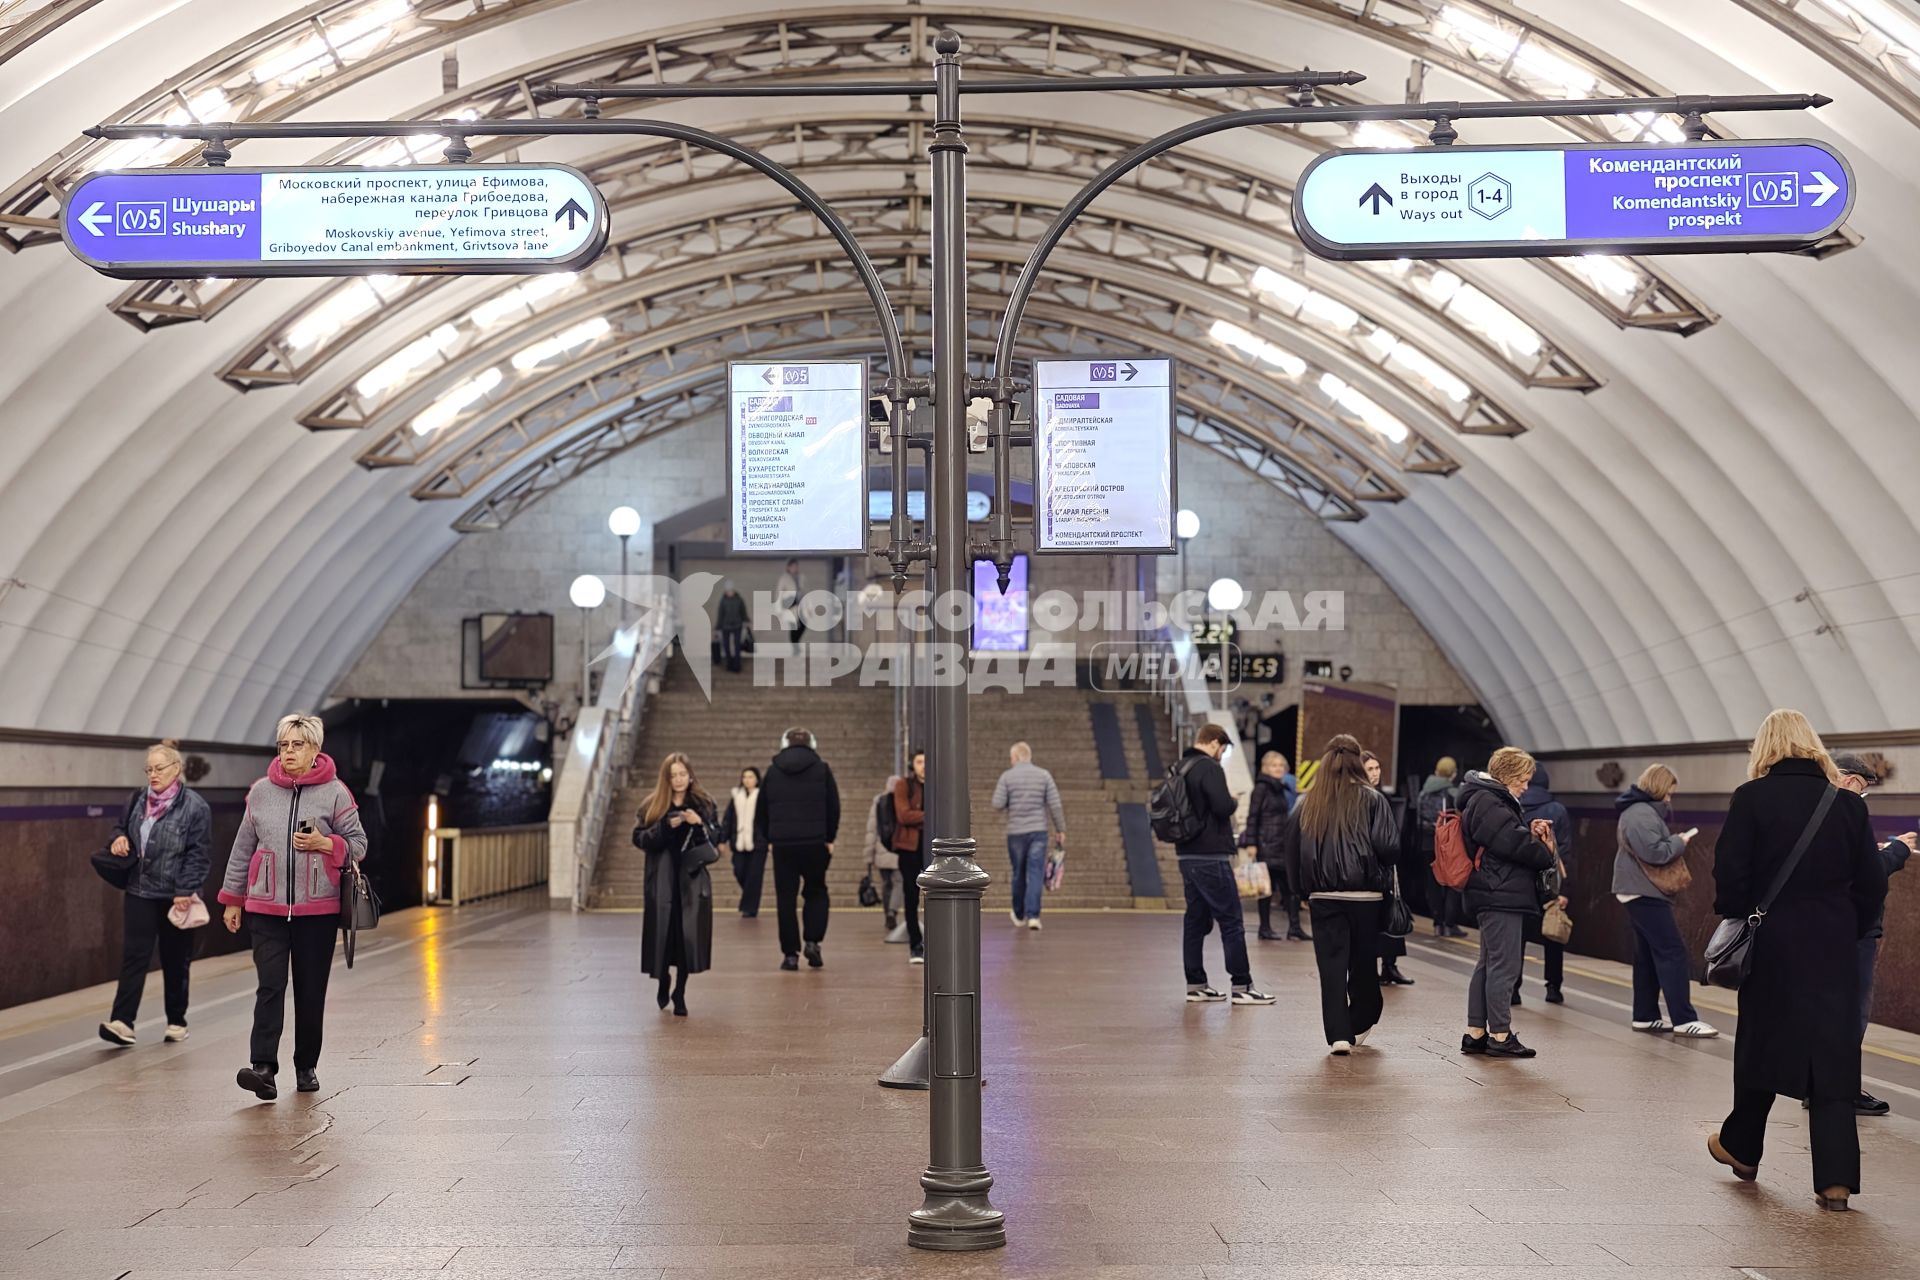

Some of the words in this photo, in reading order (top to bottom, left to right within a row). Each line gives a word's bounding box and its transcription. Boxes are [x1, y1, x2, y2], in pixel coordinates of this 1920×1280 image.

[1590, 154, 1742, 173] Комендантский
[280, 177, 361, 190] Московский
[366, 179, 432, 190] проспект,
[436, 178, 477, 190] улица
[482, 177, 548, 189] Ефимова,
[1400, 173, 1462, 184] Выходы
[1655, 174, 1742, 192] проспект
[322, 192, 405, 206] набережная
[410, 193, 458, 203] канала
[464, 191, 548, 204] Грибоедова,
[1401, 191, 1408, 199] в
[1415, 190, 1458, 202] город
[1477, 188, 1502, 203] 1-4
[1613, 193, 1742, 210] Komendantskiy
[172, 197, 255, 215] Шушары
[415, 209, 478, 220] переулок
[484, 207, 548, 220] Гривцова
[1400, 209, 1436, 222] Ways
[1441, 209, 1463, 219] out
[1668, 212, 1742, 230] prospekt
[172, 221, 246, 238] Shushary
[326, 228, 394, 240] Moskovskiy
[399, 230, 445, 238] avenue,
[450, 227, 506, 237] Yefimova
[511, 228, 548, 238] street,
[269, 243, 336, 254] Griboyedov
[341, 242, 373, 252] Canal
[377, 242, 458, 252] embankment,
[463, 241, 518, 251] Grivtsova
[523, 241, 549, 250] lane
[1055, 394, 1085, 402] САДОВАЯ
[1055, 416, 1113, 425] ДМИРАЛТЕЙСКАЯ
